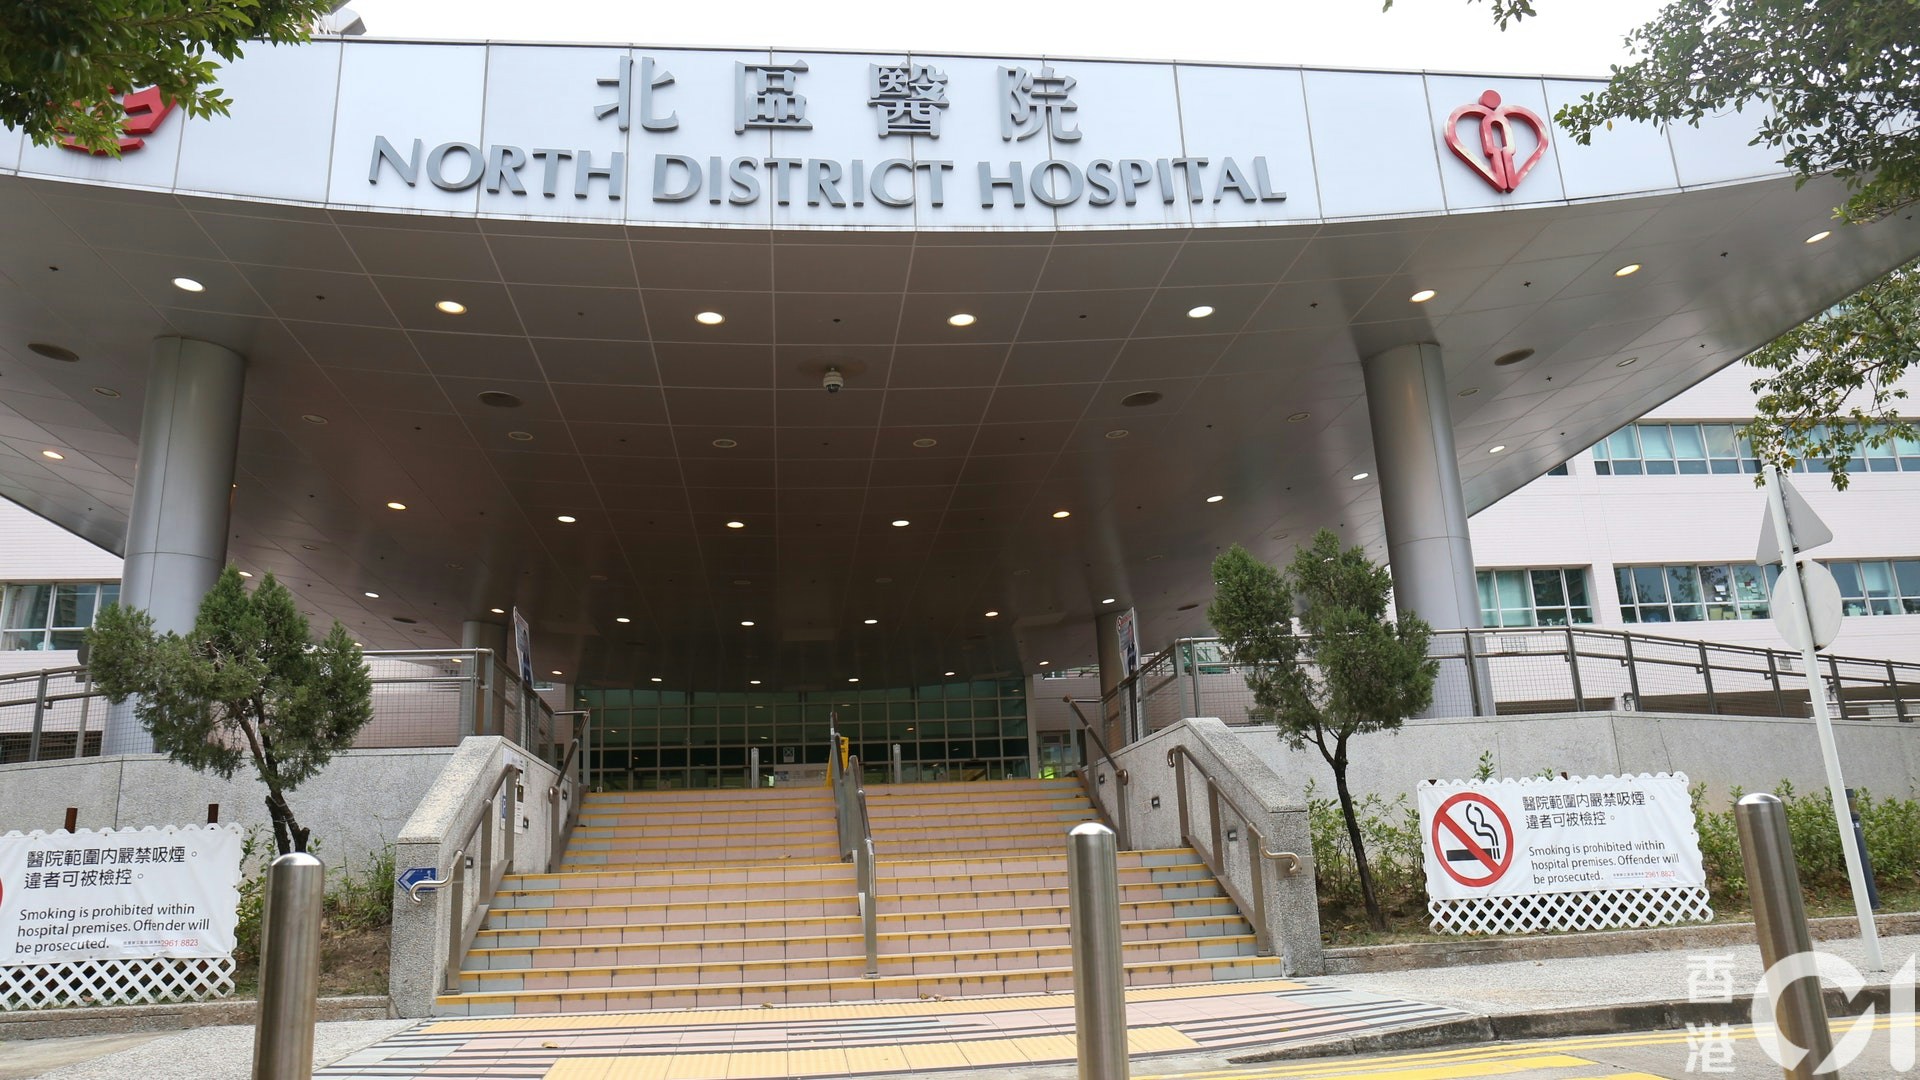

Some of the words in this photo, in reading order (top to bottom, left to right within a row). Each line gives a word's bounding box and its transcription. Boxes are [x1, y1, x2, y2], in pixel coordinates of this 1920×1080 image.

[594, 55, 1083, 143] 北區醫院
[369, 135, 626, 200] NORTH
[652, 155, 955, 208] DISTRICT
[977, 156, 1288, 210] HOSPITAL
[1528, 844, 1571, 858] Smoking
[1572, 844, 1581, 854] is
[1583, 840, 1633, 856] prohibited
[1634, 840, 1666, 851] within
[1531, 857, 1570, 872] hospital
[1571, 856, 1617, 870] premises.
[1618, 853, 1661, 866] Offender
[1663, 853, 1680, 865] will
[1533, 873, 1546, 885] be
[1547, 870, 1604, 884] prosecuted.
[19, 908, 76, 922] Smoking
[79, 907, 89, 918] is
[92, 904, 153, 921] prohibited
[157, 904, 195, 916] within
[17, 923, 69, 940] hospital
[72, 921, 131, 938] premises.
[133, 919, 186, 932] Offender
[188, 918, 210, 931] will
[15, 940, 32, 954] be
[35, 937, 109, 953] prosecuted.
